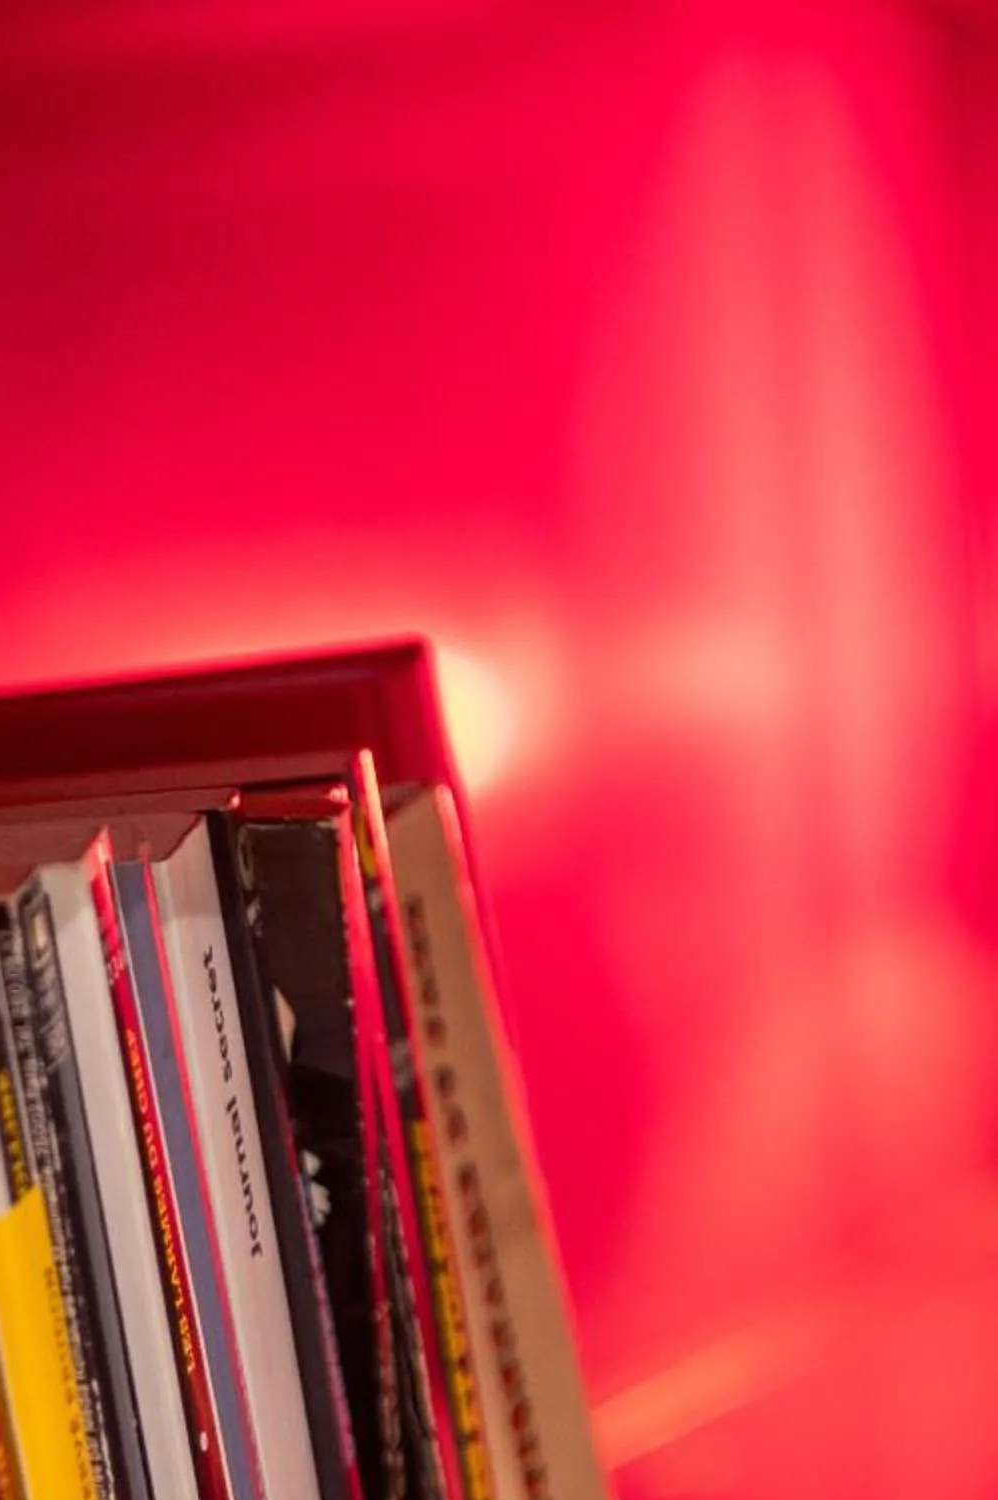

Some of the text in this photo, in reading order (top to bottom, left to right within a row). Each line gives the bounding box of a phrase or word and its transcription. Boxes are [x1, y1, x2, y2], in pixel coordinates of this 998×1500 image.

[143, 1121, 158, 1170] DU
[203, 944, 263, 1258] Journal secret
[153, 1173, 184, 1309] LARMES
[179, 1312, 196, 1374] LES
